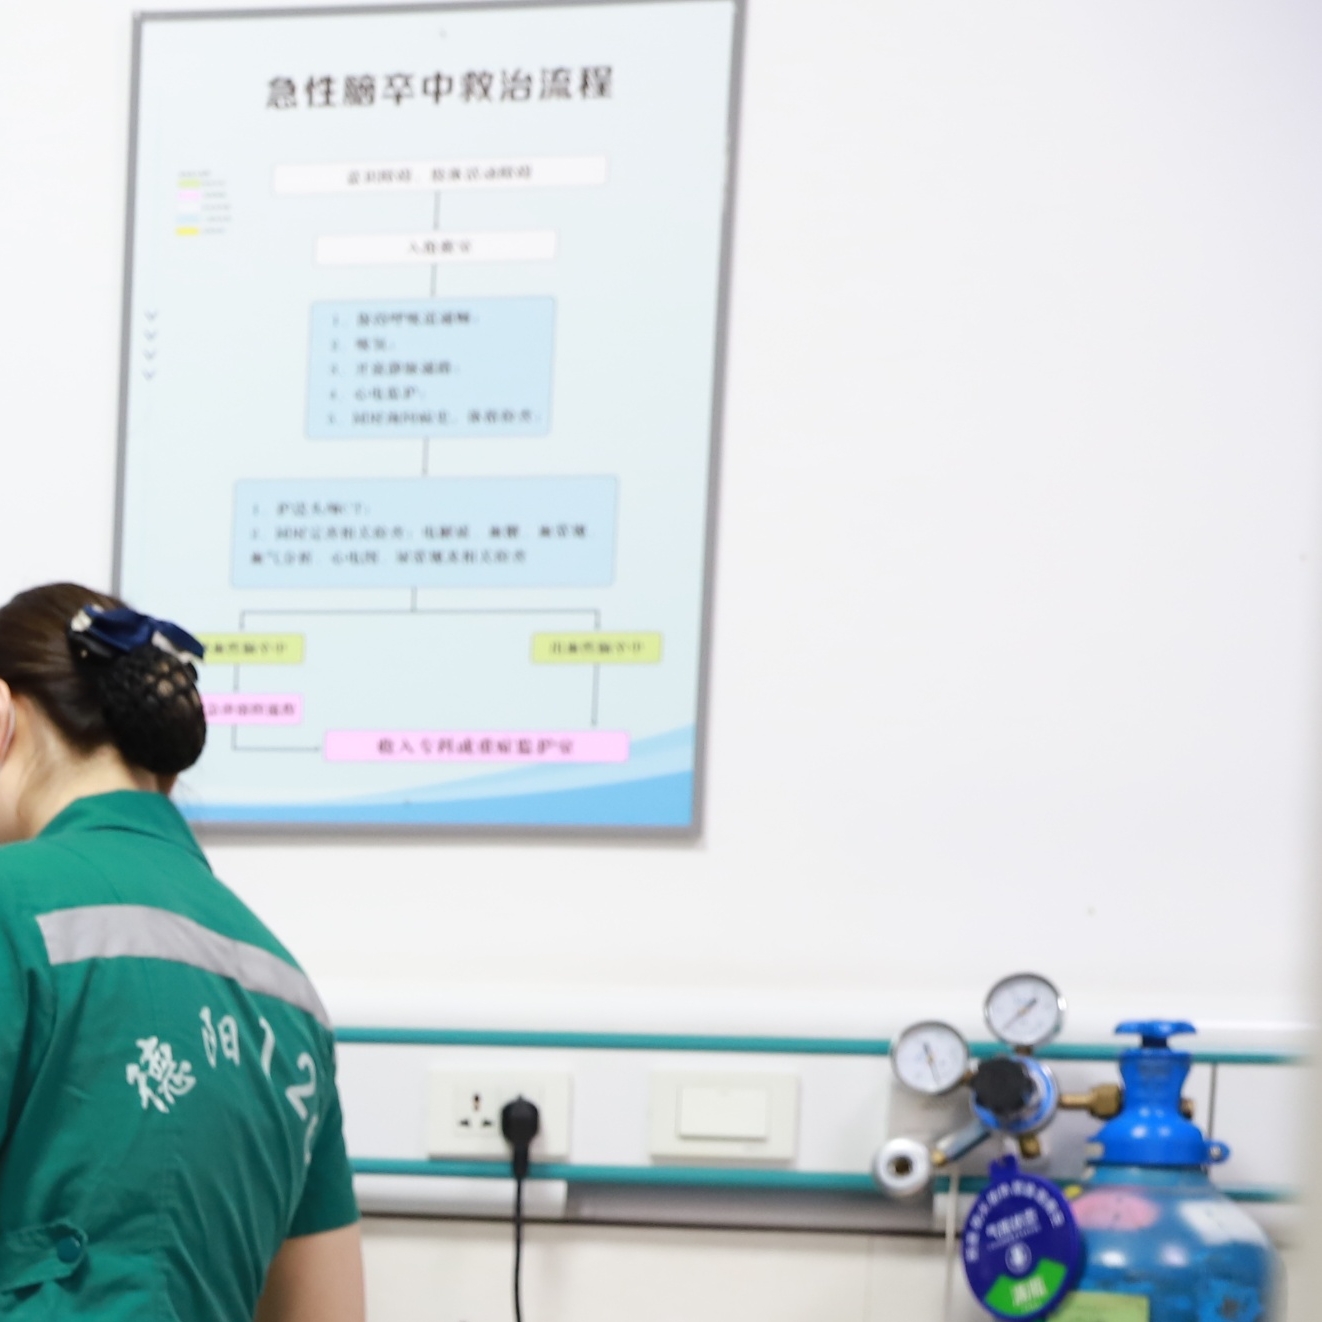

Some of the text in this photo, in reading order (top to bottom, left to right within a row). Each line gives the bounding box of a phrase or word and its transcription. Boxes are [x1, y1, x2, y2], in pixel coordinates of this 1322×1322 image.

[265, 65, 614, 110] 急性脑卒中救治流程
